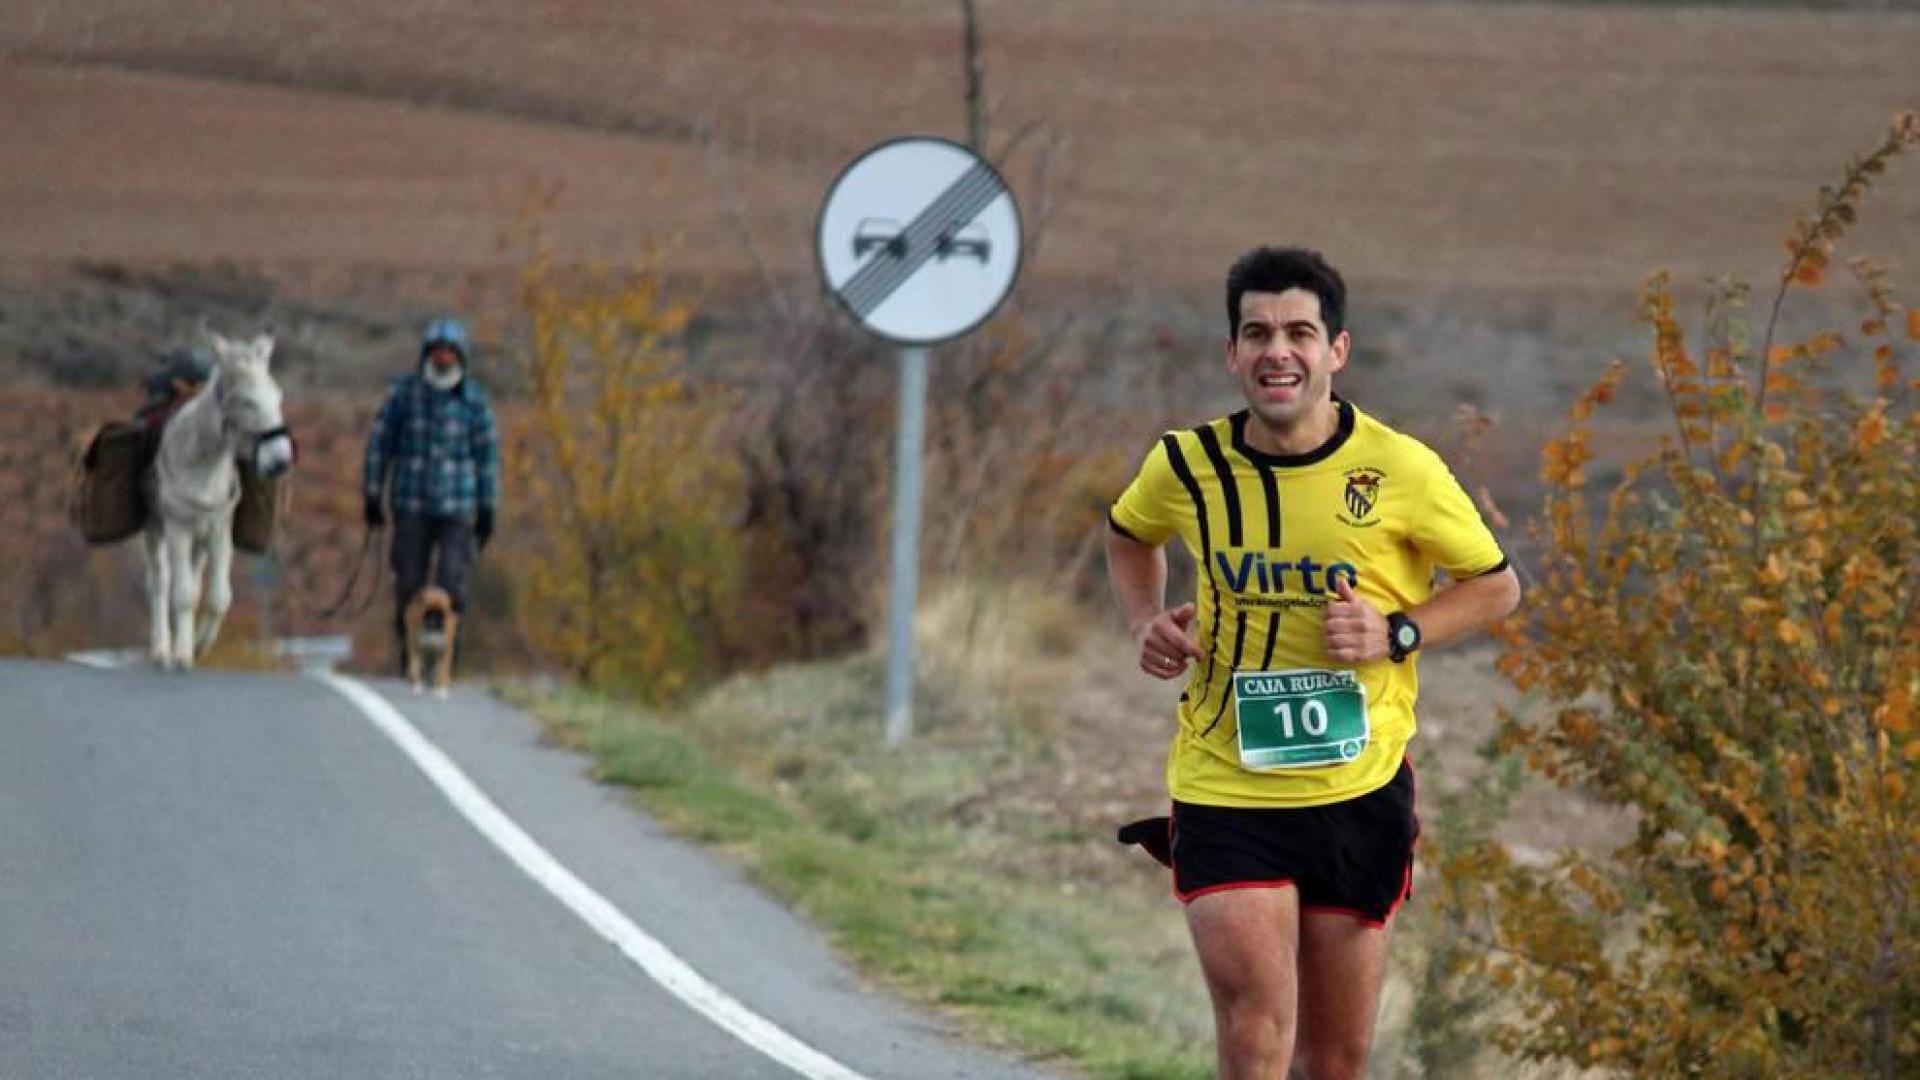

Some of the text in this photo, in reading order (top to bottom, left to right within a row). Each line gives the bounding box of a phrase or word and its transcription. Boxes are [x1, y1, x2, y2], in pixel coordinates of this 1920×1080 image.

[1215, 552, 1358, 595] Virto
[1244, 679, 1286, 694] CAJA
[1273, 700, 1328, 738] 10
